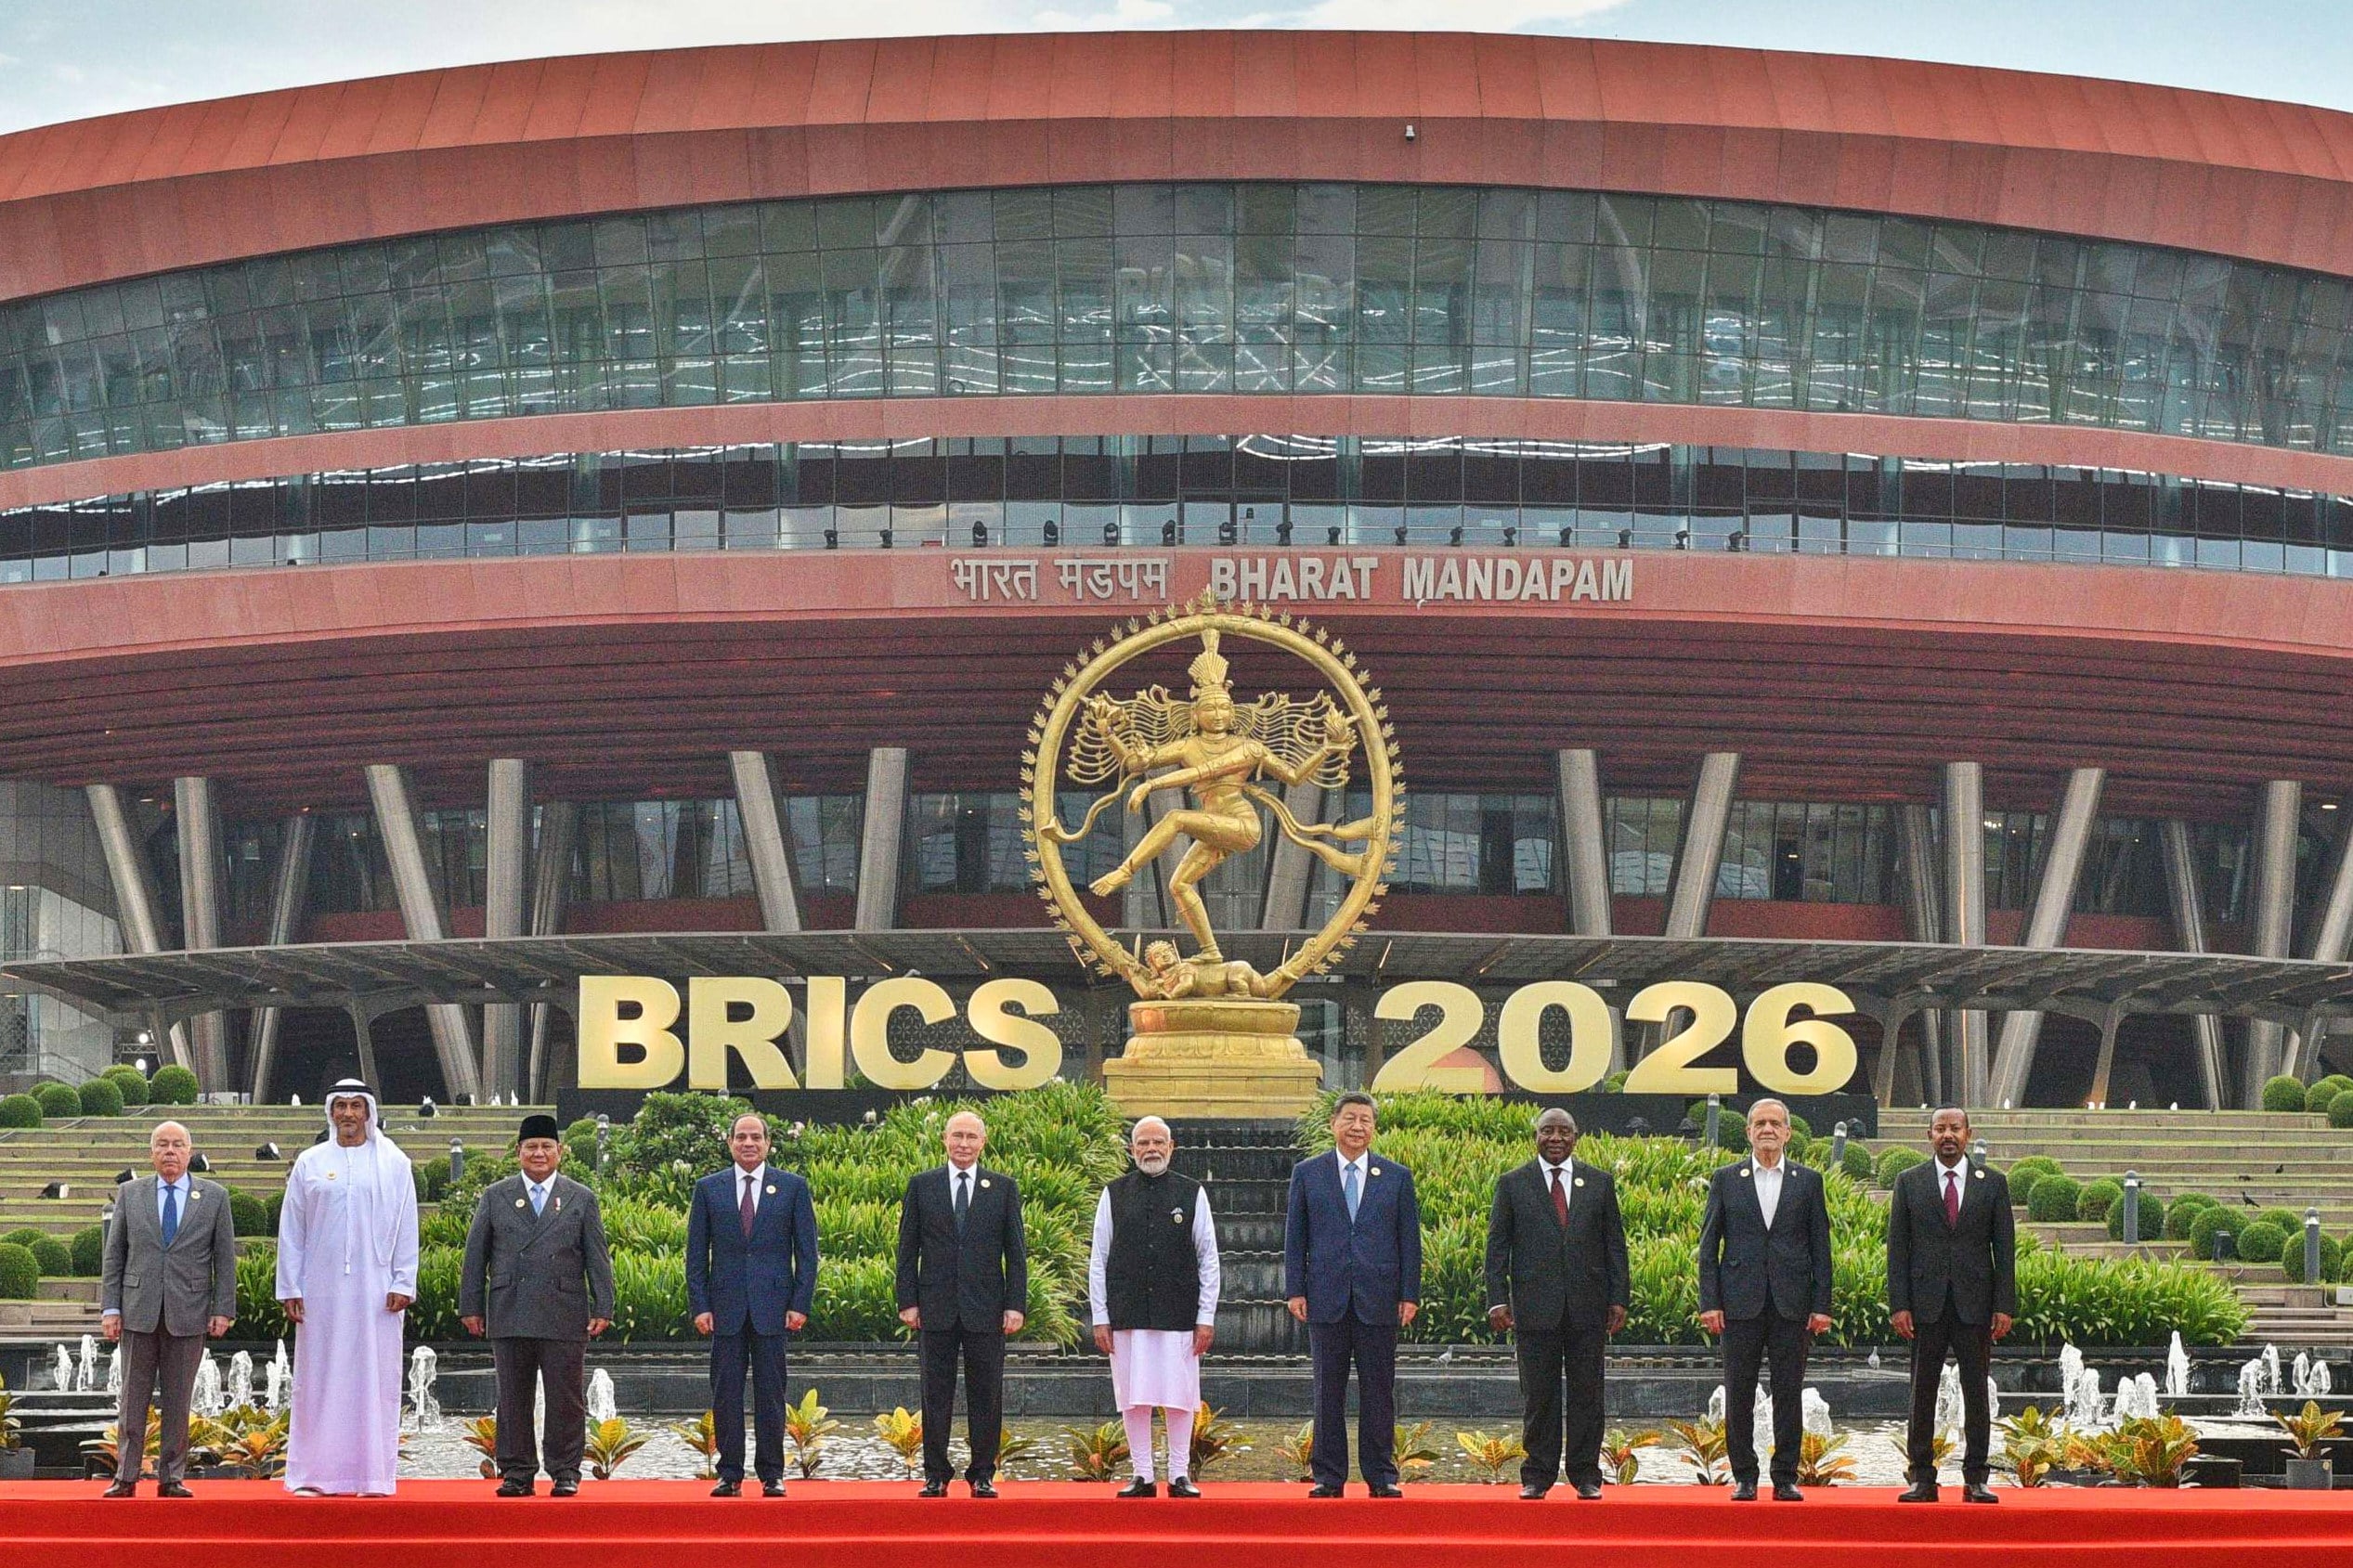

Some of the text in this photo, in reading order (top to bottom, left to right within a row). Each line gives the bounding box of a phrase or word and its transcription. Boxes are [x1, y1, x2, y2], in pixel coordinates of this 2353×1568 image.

[951, 558, 1039, 600] भारत
[1211, 557, 1633, 601] BHARAT MANDAPAM
[578, 975, 1857, 1095] BRICS 2026
